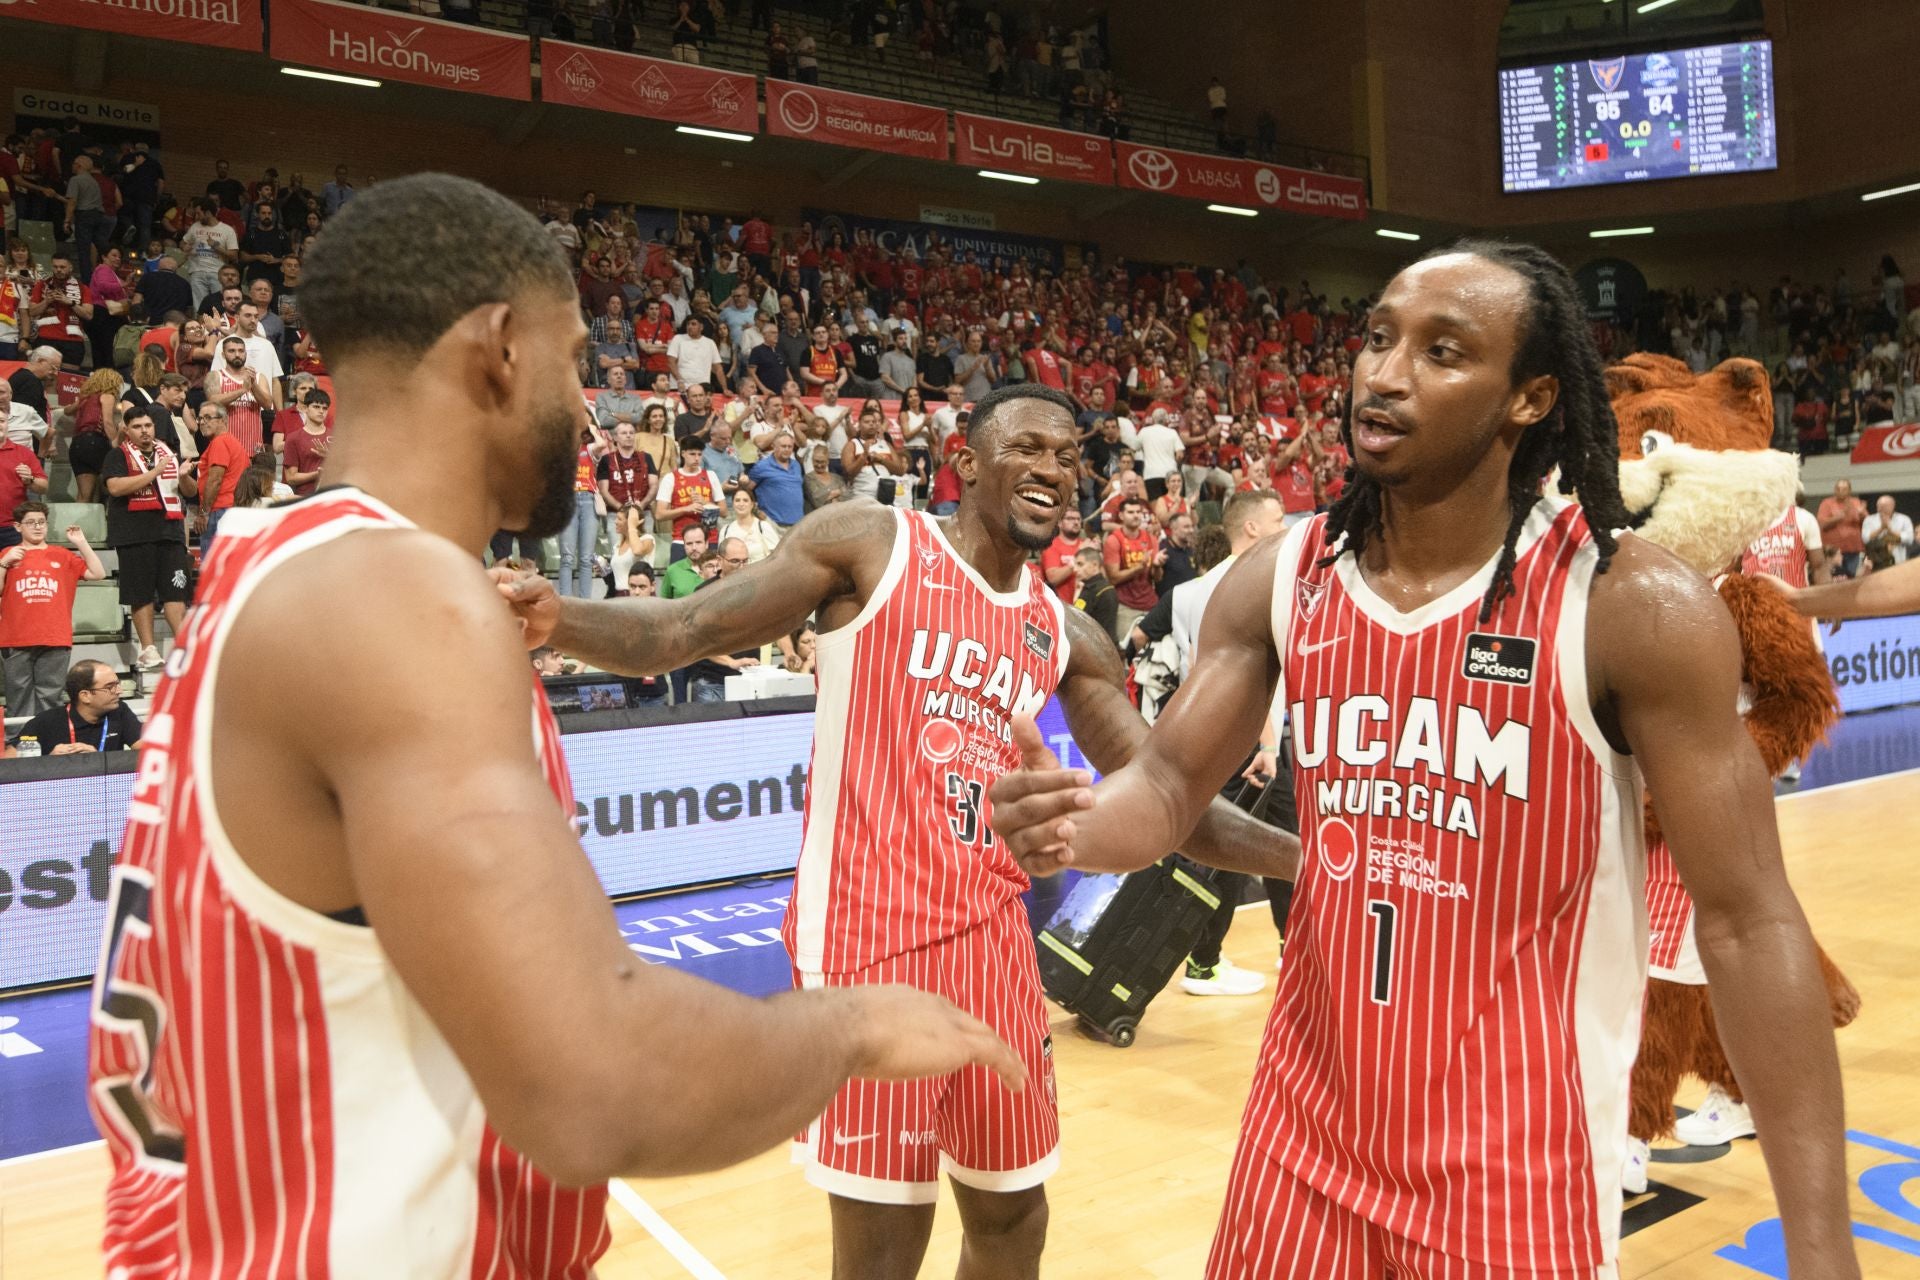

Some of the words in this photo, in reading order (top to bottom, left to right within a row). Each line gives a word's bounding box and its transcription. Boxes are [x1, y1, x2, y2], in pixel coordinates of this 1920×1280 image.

[565, 71, 595, 89] Niña
[640, 85, 669, 100] Niña
[22, 94, 89, 116] Grada
[98, 103, 153, 123] Norte
[711, 97, 739, 112] Niña
[1648, 95, 1674, 116] 64
[874, 124, 890, 137] DE
[893, 127, 937, 144] MURCIA
[1619, 120, 1651, 139] 0.0
[1632, 146, 1641, 159] 4
[1187, 167, 1243, 189] LABASA
[1750, 534, 1795, 555] UCAM
[15, 576, 59, 593] UCAM
[22, 589, 53, 599] MURCIA
[1470, 646, 1498, 664] liga
[1824, 637, 1920, 687] estión
[906, 628, 1047, 723] UCAM
[1468, 661, 1529, 680] endesa
[923, 689, 1013, 748] MURCIA
[961, 750, 976, 765] DE
[1290, 693, 1531, 803] UCAM
[1317, 778, 1480, 840] MURCIA
[1370, 835, 1399, 848] Costa
[1368, 849, 1436, 877] REGIÓN
[1367, 866, 1394, 885] DE
[1399, 870, 1470, 900] MURCIA
[1368, 899, 1399, 1007] 1
